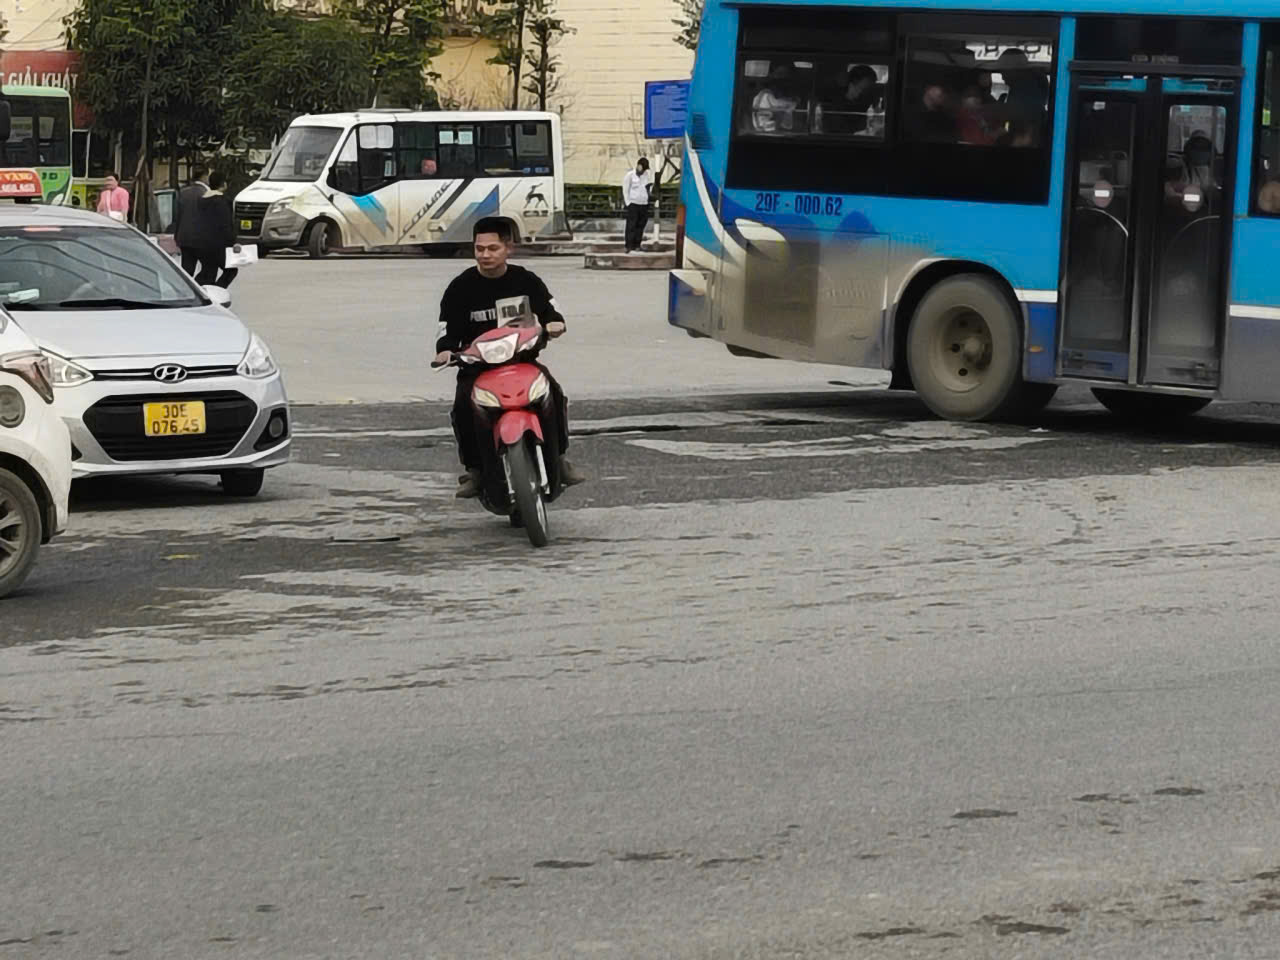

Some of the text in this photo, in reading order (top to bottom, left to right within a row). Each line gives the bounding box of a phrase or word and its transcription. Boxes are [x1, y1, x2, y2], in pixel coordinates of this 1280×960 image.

[754, 191, 780, 213] 29F
[793, 193, 843, 217] 000.62
[161, 404, 189, 419] 30E
